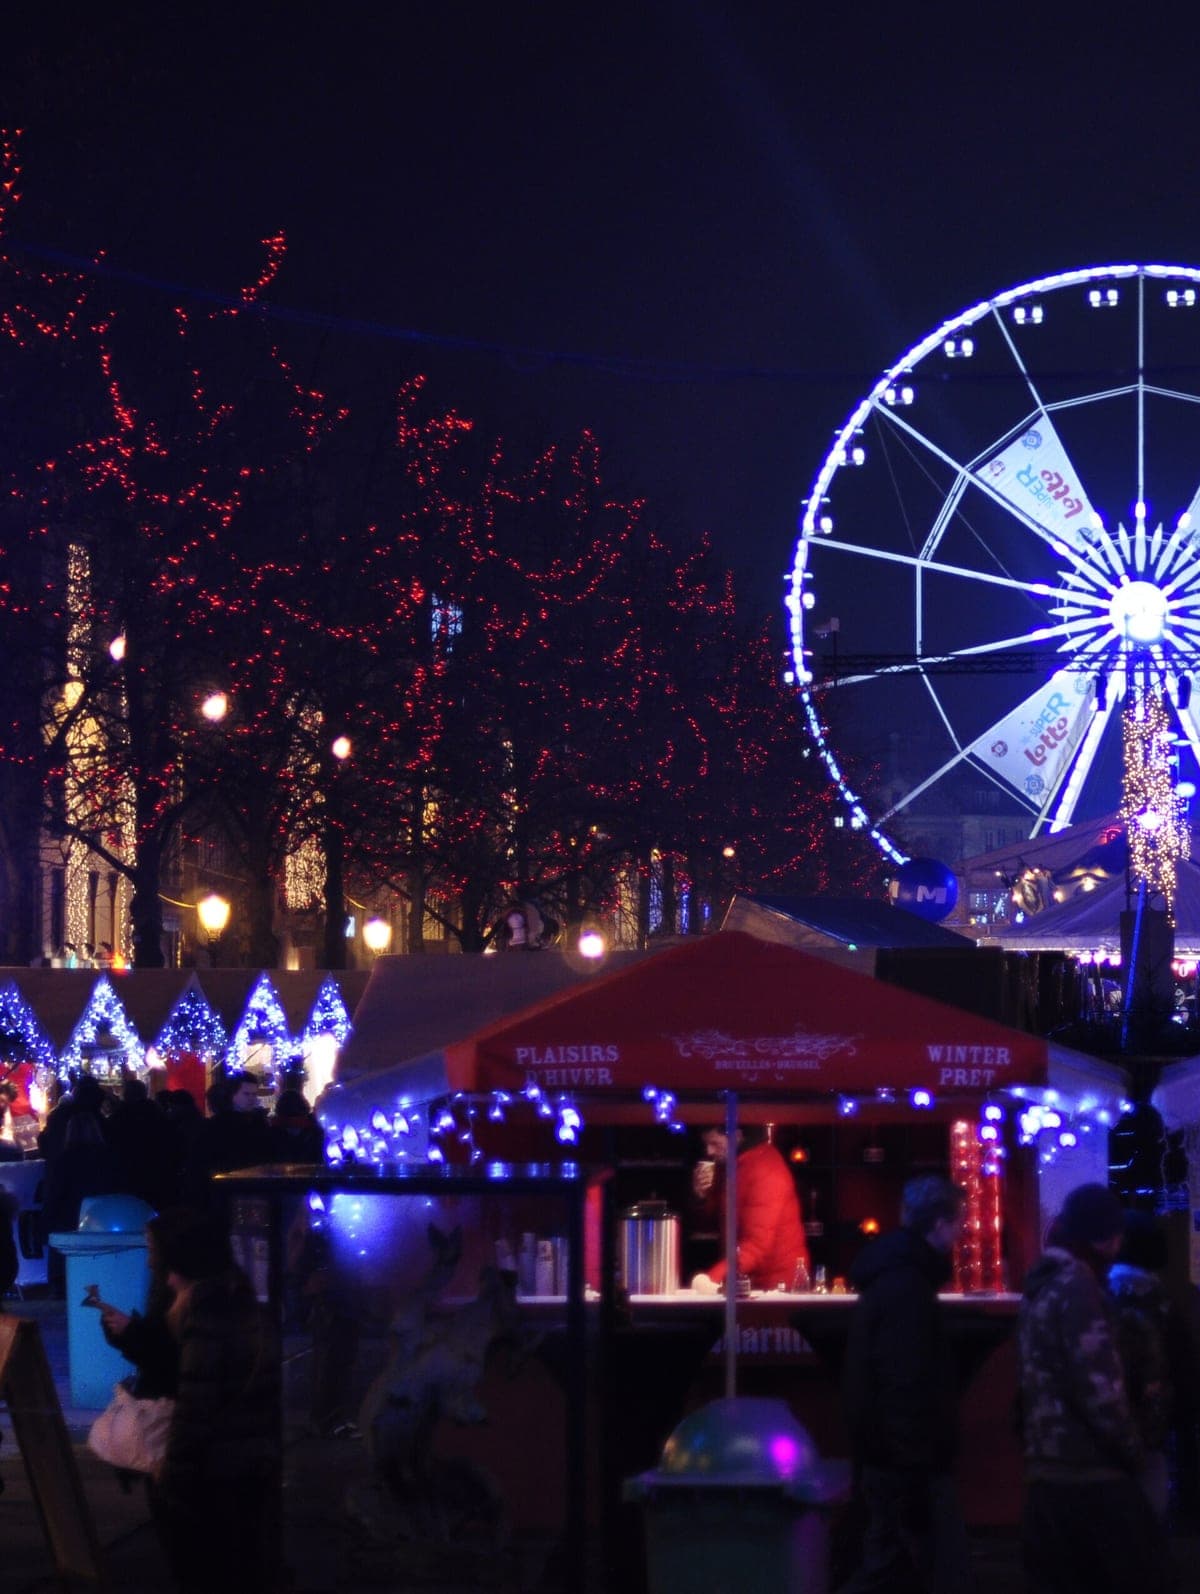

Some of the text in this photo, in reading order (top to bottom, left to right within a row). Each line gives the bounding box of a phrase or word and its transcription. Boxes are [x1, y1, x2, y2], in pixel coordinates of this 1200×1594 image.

[516, 1045, 620, 1064] PLAISIRS
[926, 1045, 1011, 1065] WINTER
[525, 1067, 614, 1086] D'HIVER
[939, 1068, 995, 1087] PRET
